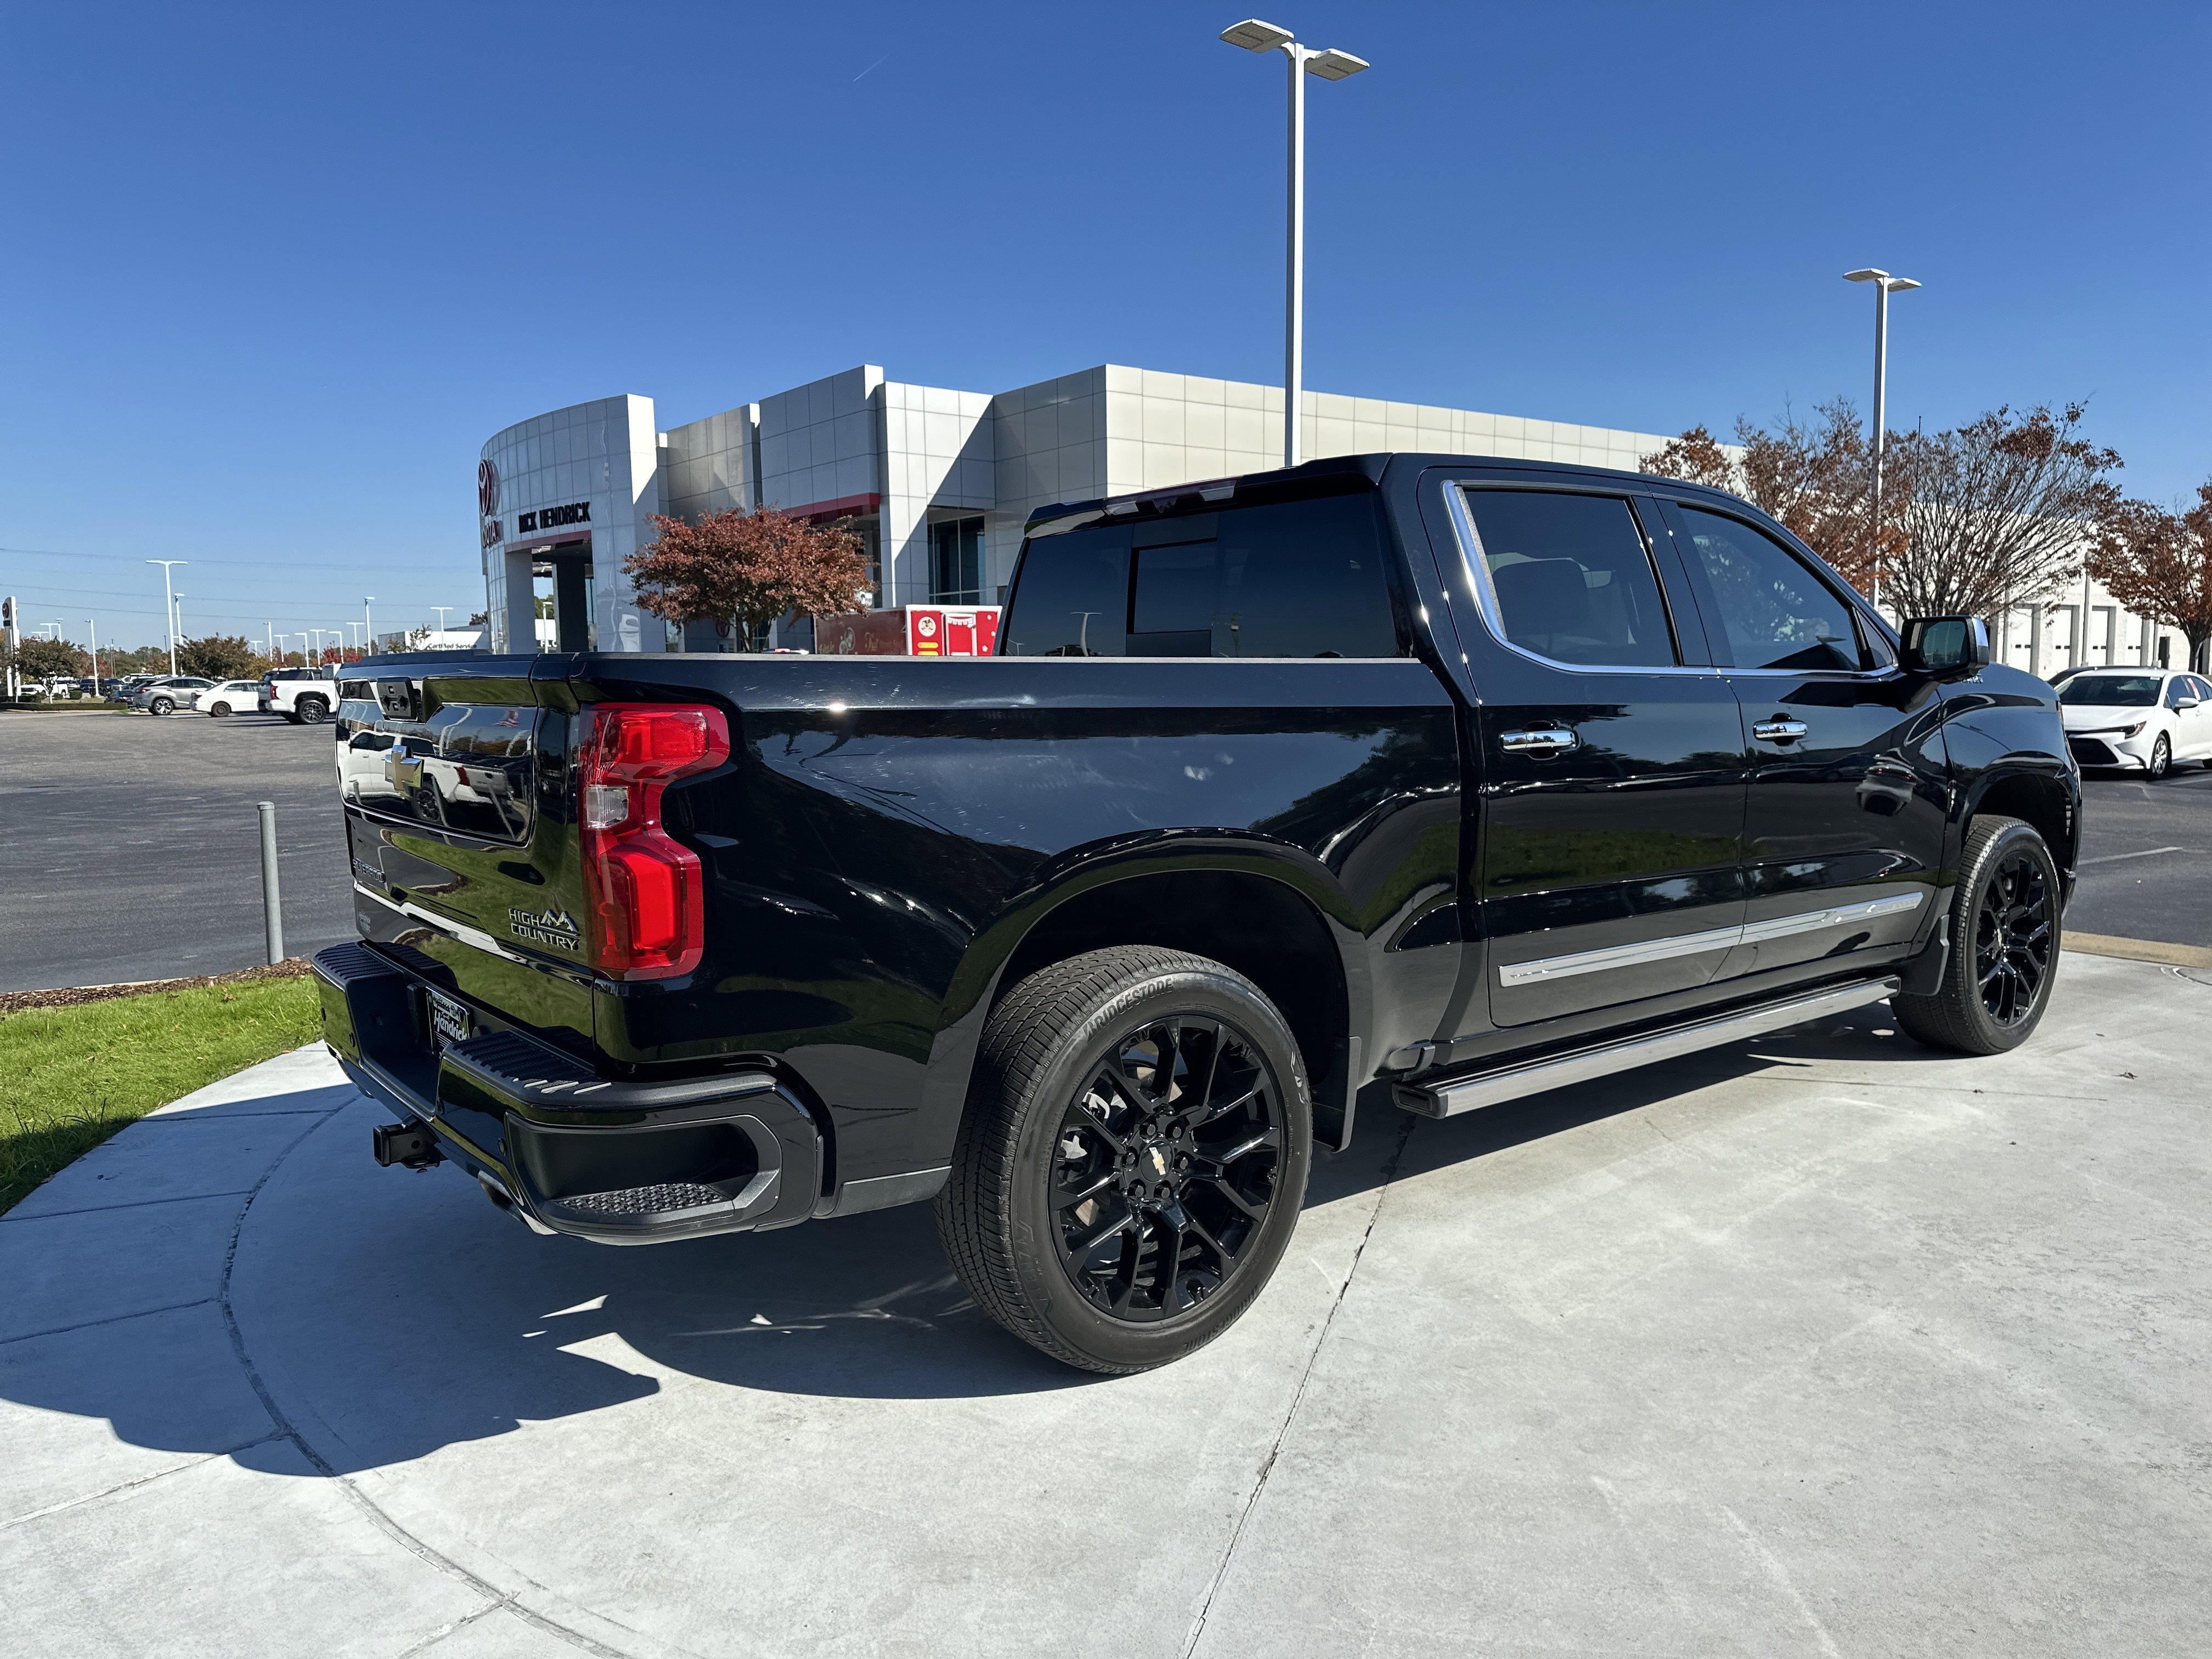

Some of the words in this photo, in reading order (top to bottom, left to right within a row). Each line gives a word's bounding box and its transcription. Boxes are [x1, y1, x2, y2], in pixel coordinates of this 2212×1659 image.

[518, 511, 538, 533] RICK
[539, 501, 591, 529] HENDRICK
[508, 907, 541, 927] HIGH
[511, 922, 580, 951] COUNTRY
[433, 1009, 467, 1041] Hendrick
[1082, 978, 1173, 1043] BRIDGESTONE
